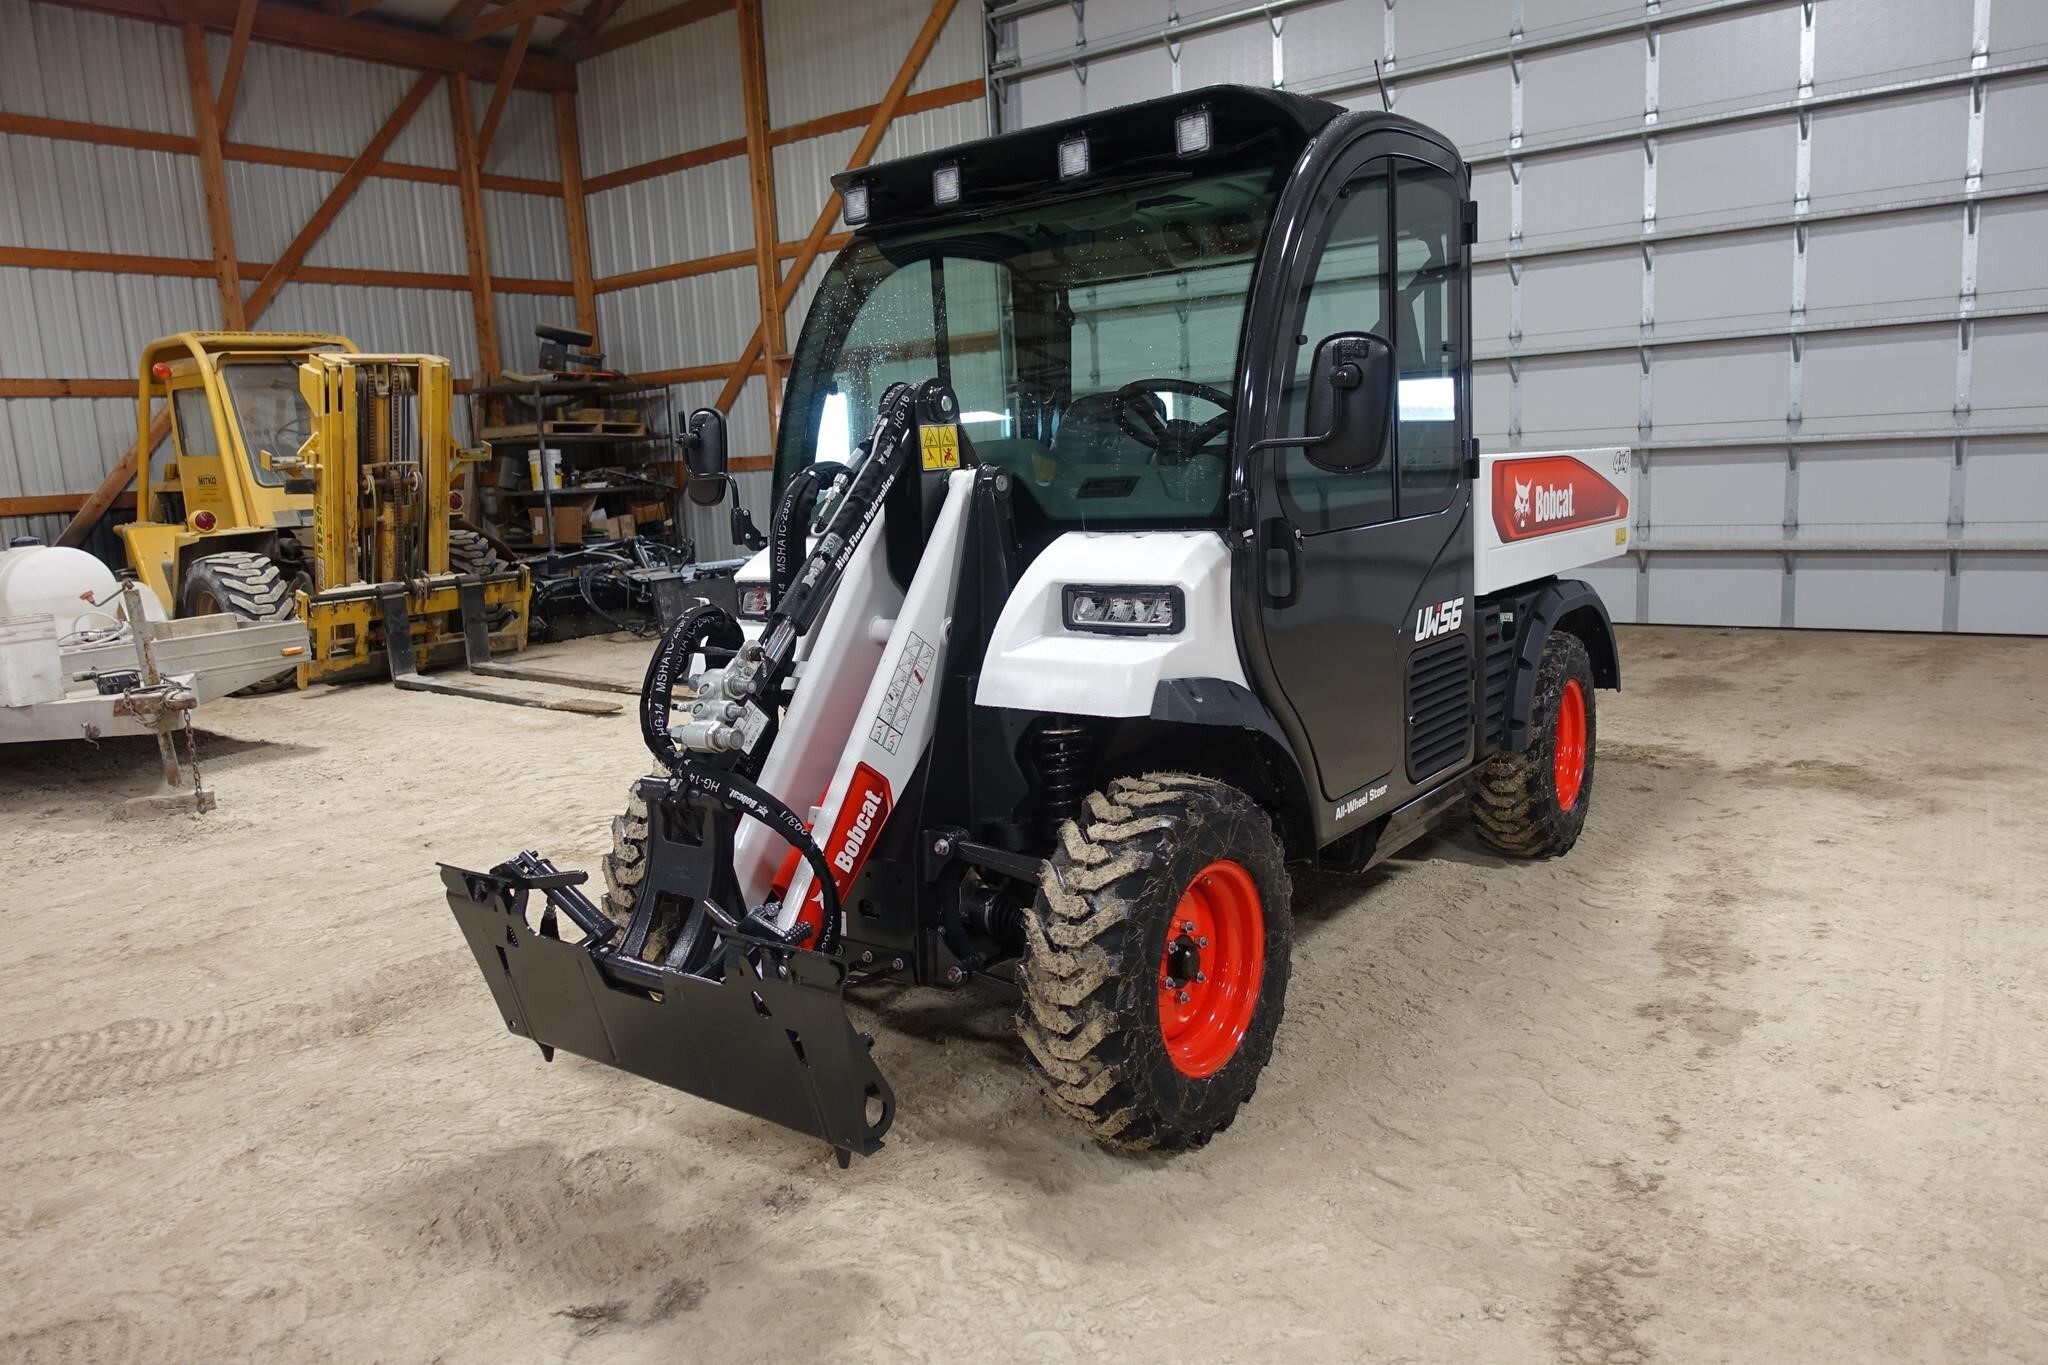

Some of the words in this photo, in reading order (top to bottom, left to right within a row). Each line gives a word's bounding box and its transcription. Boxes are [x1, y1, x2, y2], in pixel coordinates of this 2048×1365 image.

[894, 395, 910, 429] HG-16
[1613, 450, 1630, 475] 4x4
[1535, 483, 1574, 523] Bobcat
[834, 547, 853, 570] High
[848, 522, 867, 548] Flow
[863, 473, 895, 522] Hydraulics
[776, 539, 787, 573] MSHA
[1414, 597, 1465, 642] UW56
[656, 656, 671, 693] MSHA
[654, 703, 668, 736] HG-14
[689, 772, 721, 793] HG-14
[729, 788, 758, 809] Bobcat
[1335, 791, 1368, 821] All-Wheel
[1369, 784, 1388, 801] Steer
[834, 788, 882, 874] Bobcat
